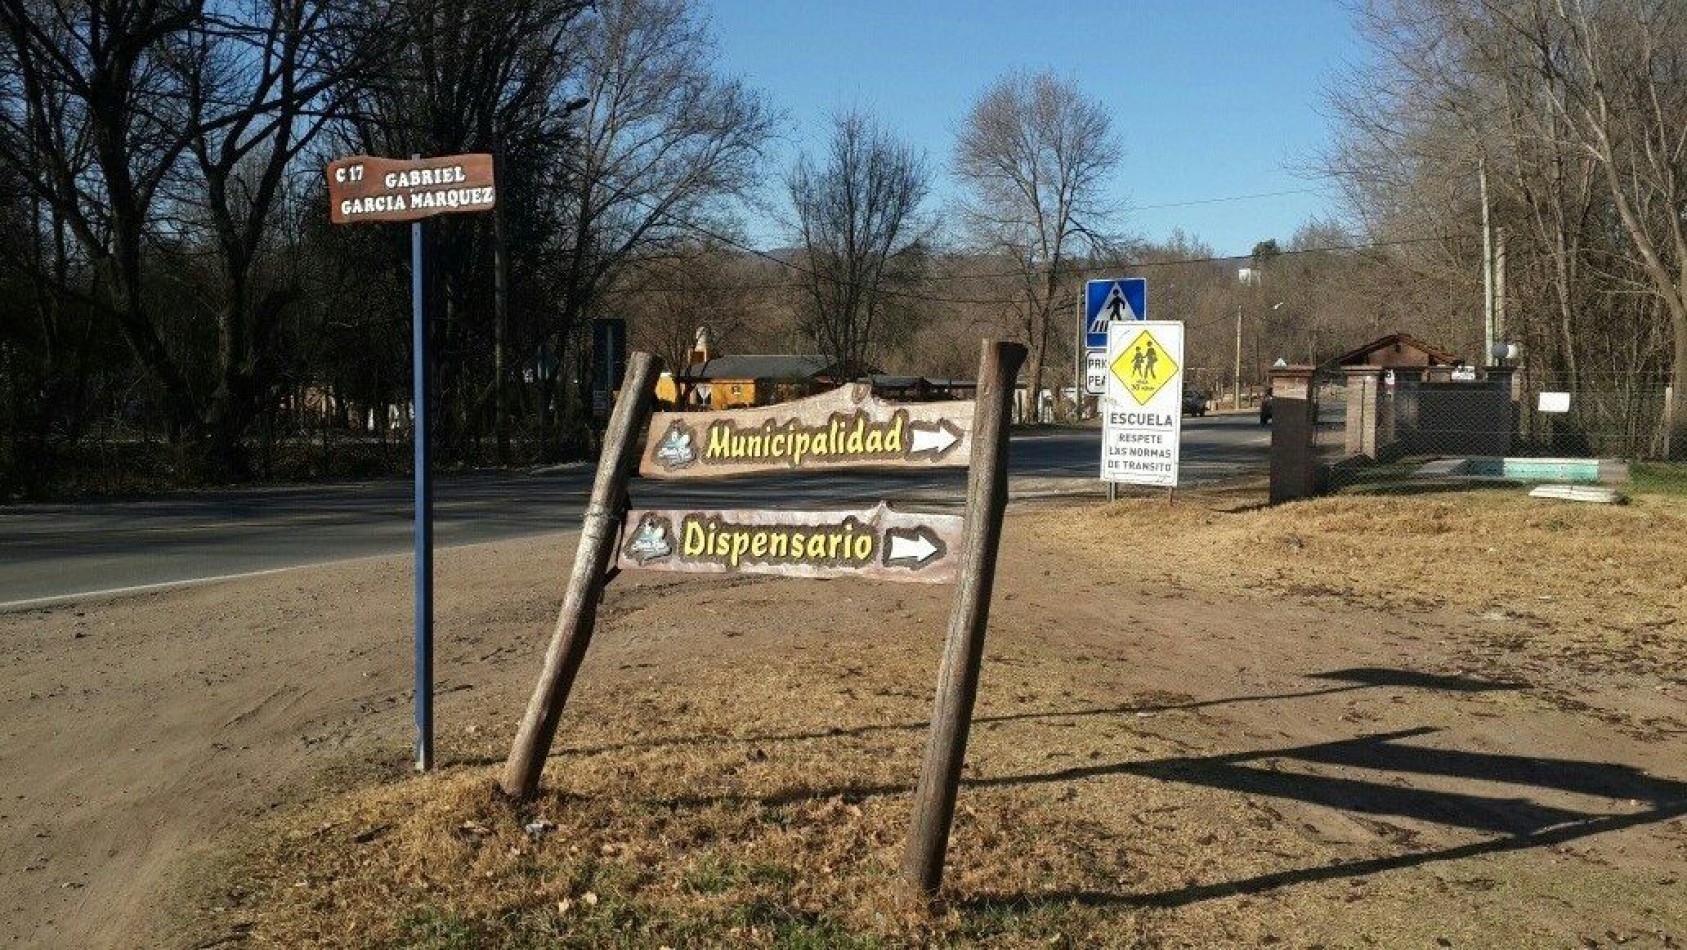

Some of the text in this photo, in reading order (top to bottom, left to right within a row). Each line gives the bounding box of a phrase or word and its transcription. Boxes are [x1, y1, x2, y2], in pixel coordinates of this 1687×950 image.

[335, 164, 364, 182] C 17
[385, 166, 467, 189] GABRIEL
[340, 187, 494, 215] GARCIA MARQUEZ
[1088, 359, 1107, 370] PRI
[1110, 412, 1173, 427] ESCUELA
[706, 416, 904, 466] Municipalidad
[1119, 433, 1163, 444] RESPETE
[1109, 446, 1171, 459] LAS NORMAS
[1108, 460, 1172, 472] DE TRANSITO
[684, 519, 873, 567] Dispensario
